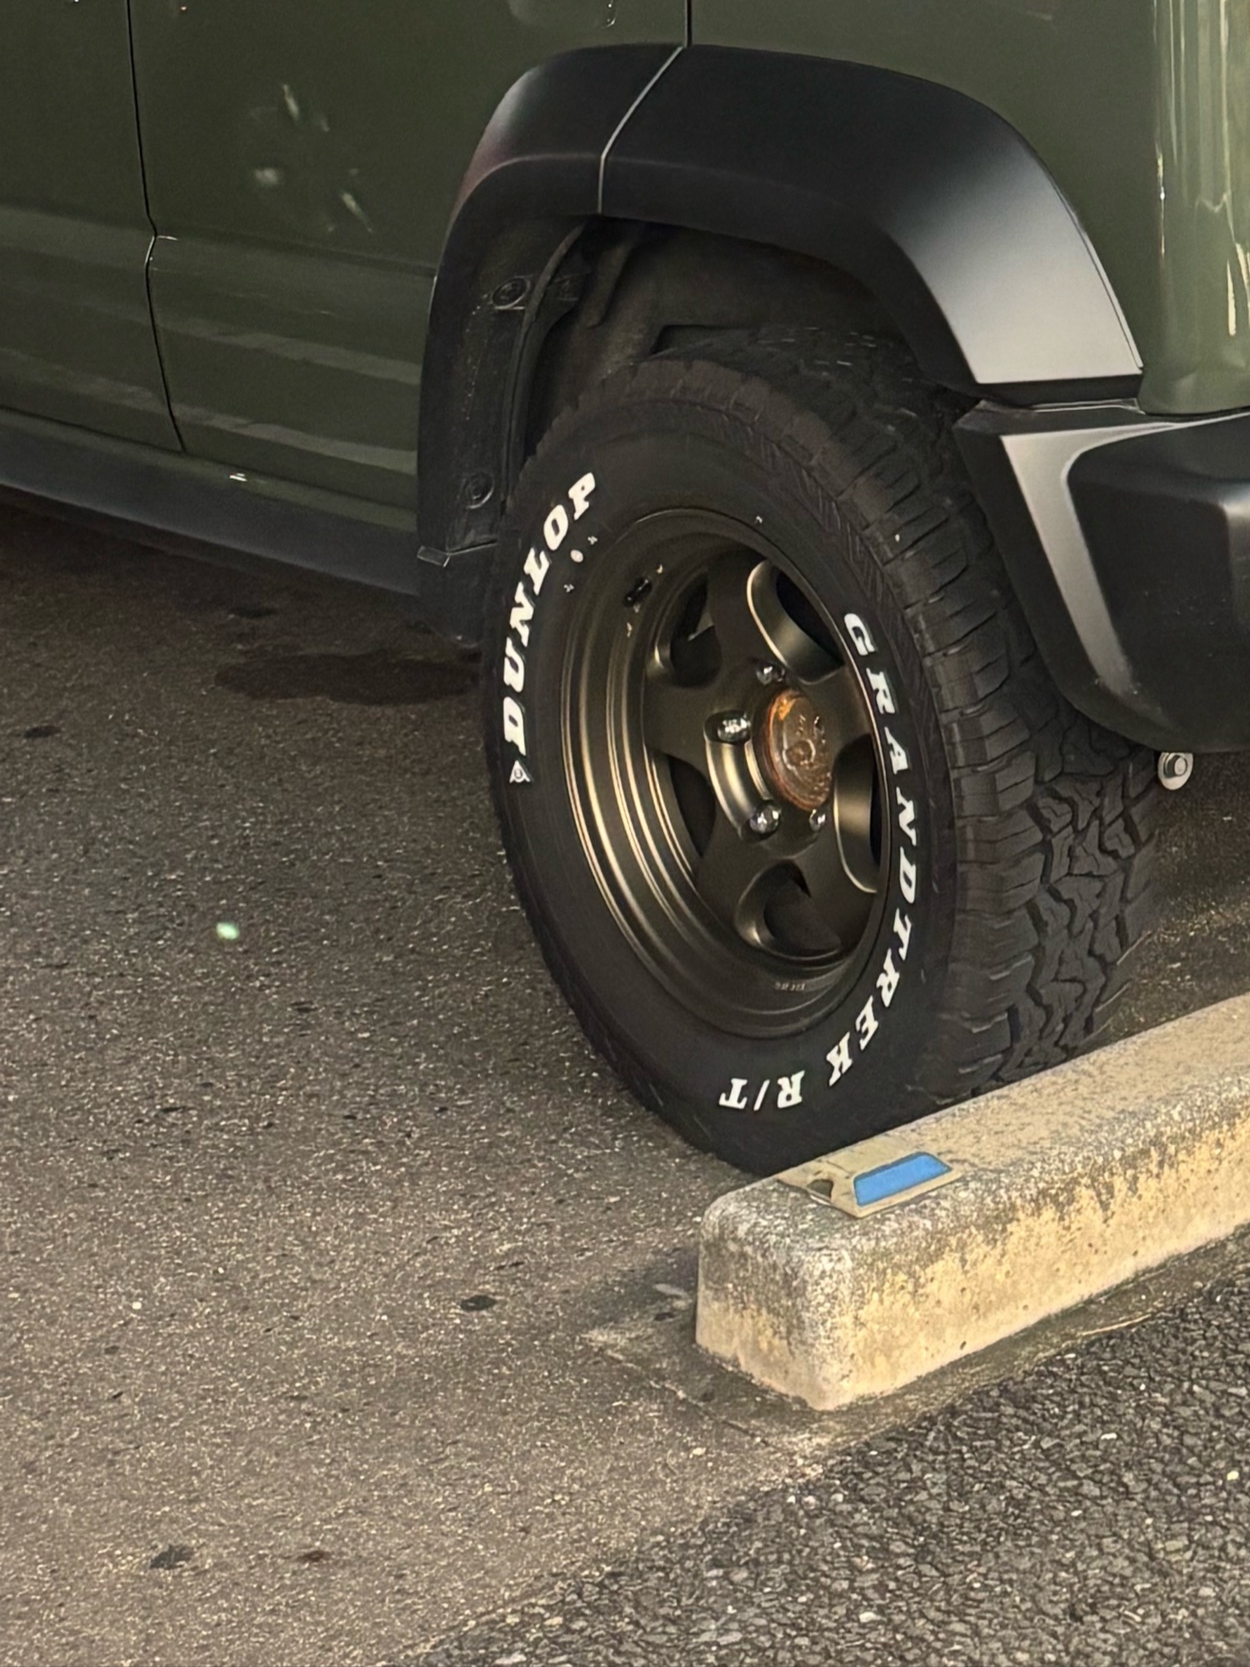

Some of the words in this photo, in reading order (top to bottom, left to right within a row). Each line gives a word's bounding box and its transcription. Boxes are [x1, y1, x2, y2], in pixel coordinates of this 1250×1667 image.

[502, 472, 597, 757] DUNLOP
[825, 612, 918, 1087] GRANDTREK
[718, 1070, 806, 1111] R/T
